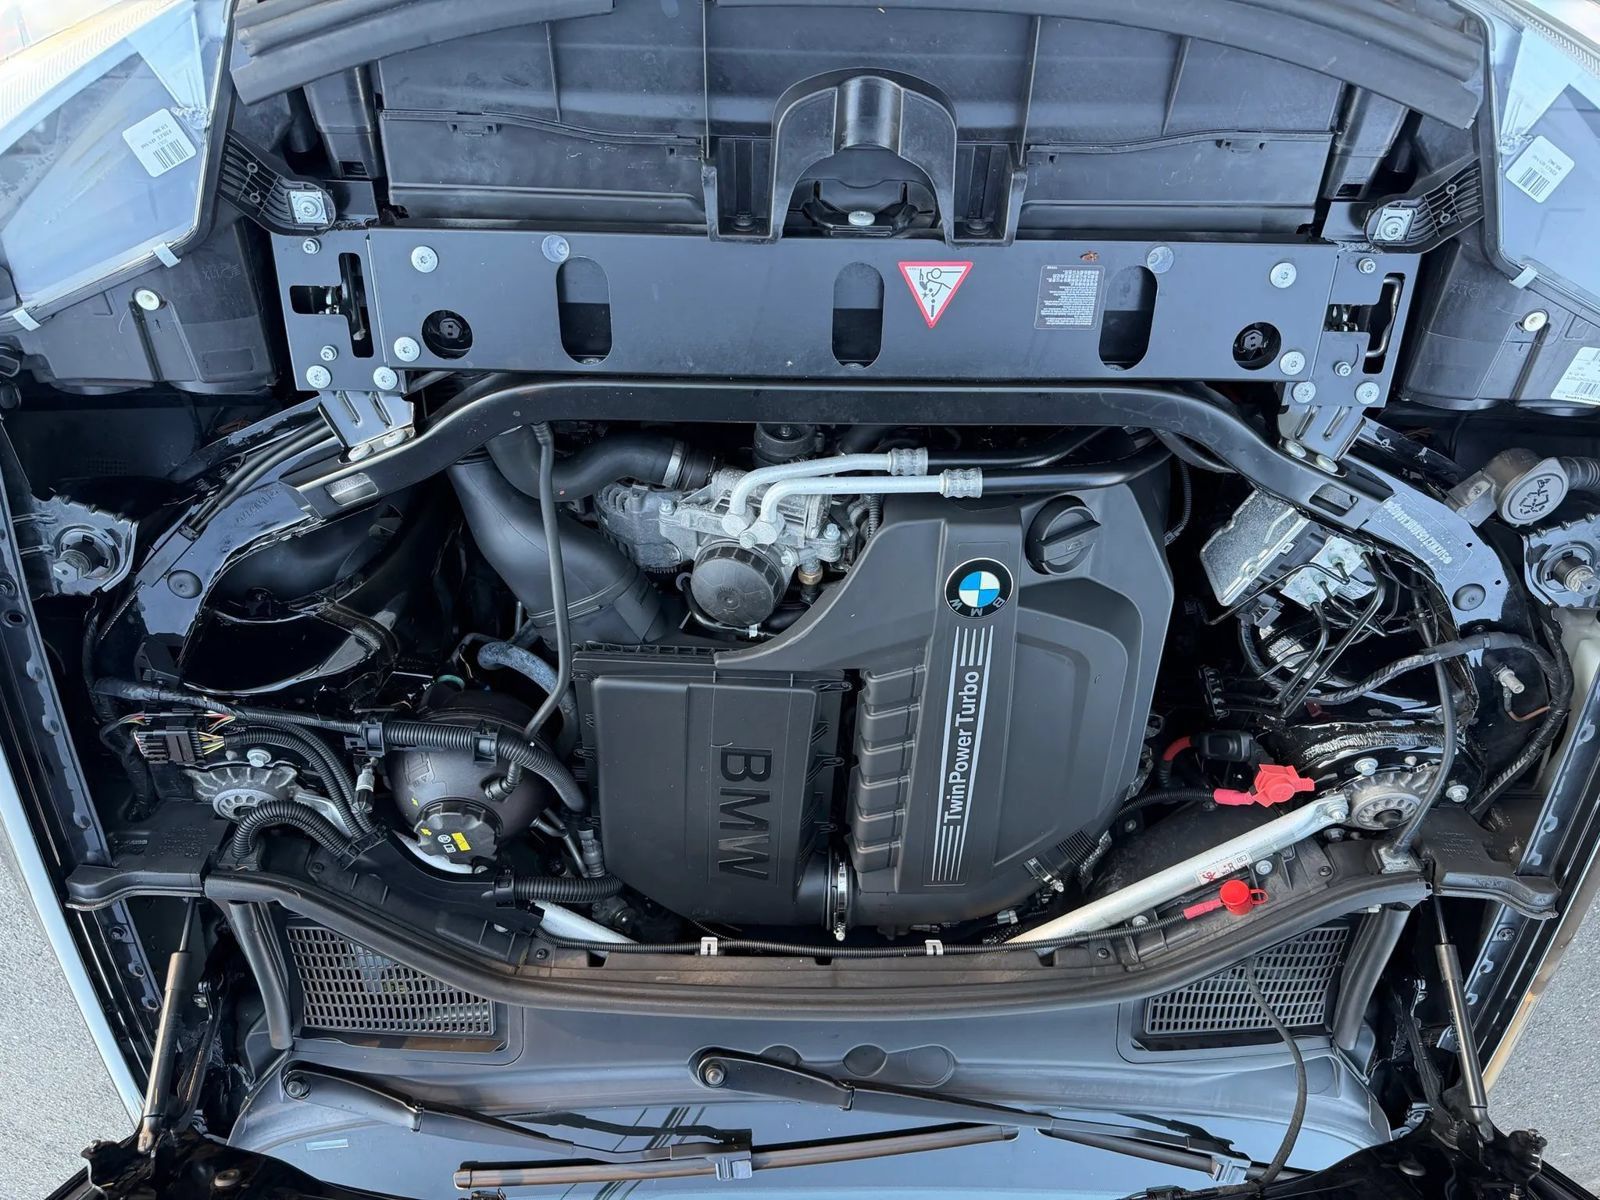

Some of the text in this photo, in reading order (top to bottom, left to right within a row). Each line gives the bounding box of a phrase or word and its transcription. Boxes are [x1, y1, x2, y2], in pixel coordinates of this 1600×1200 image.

[950, 597, 1005, 617] BMW
[718, 747, 773, 880] BMW
[944, 671, 980, 823] TwinPower Turbo
